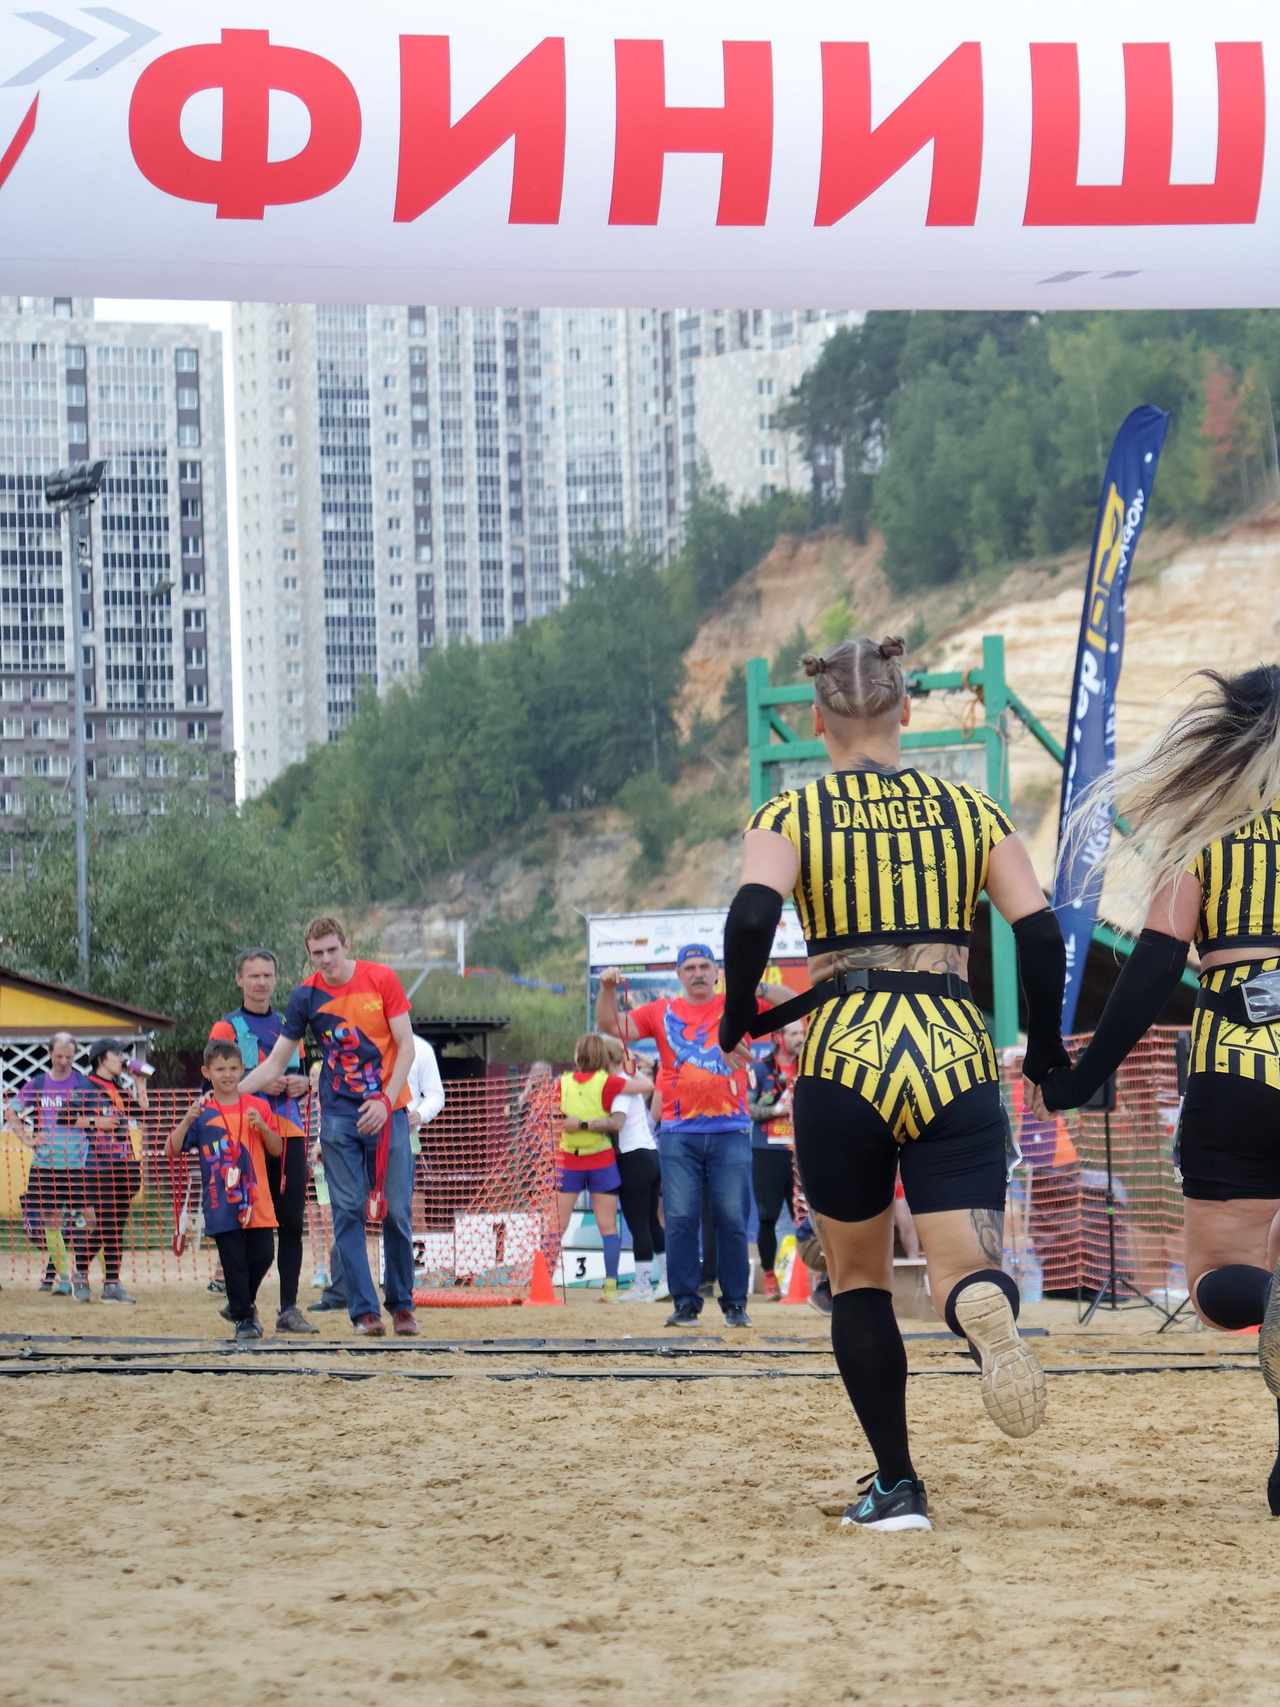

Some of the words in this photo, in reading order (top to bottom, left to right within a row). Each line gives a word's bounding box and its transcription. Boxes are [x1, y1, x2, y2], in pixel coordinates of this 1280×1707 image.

[129, 27, 1266, 227] ФИНИШ
[832, 799, 945, 829] DANGER
[575, 1256, 587, 1278] 3
